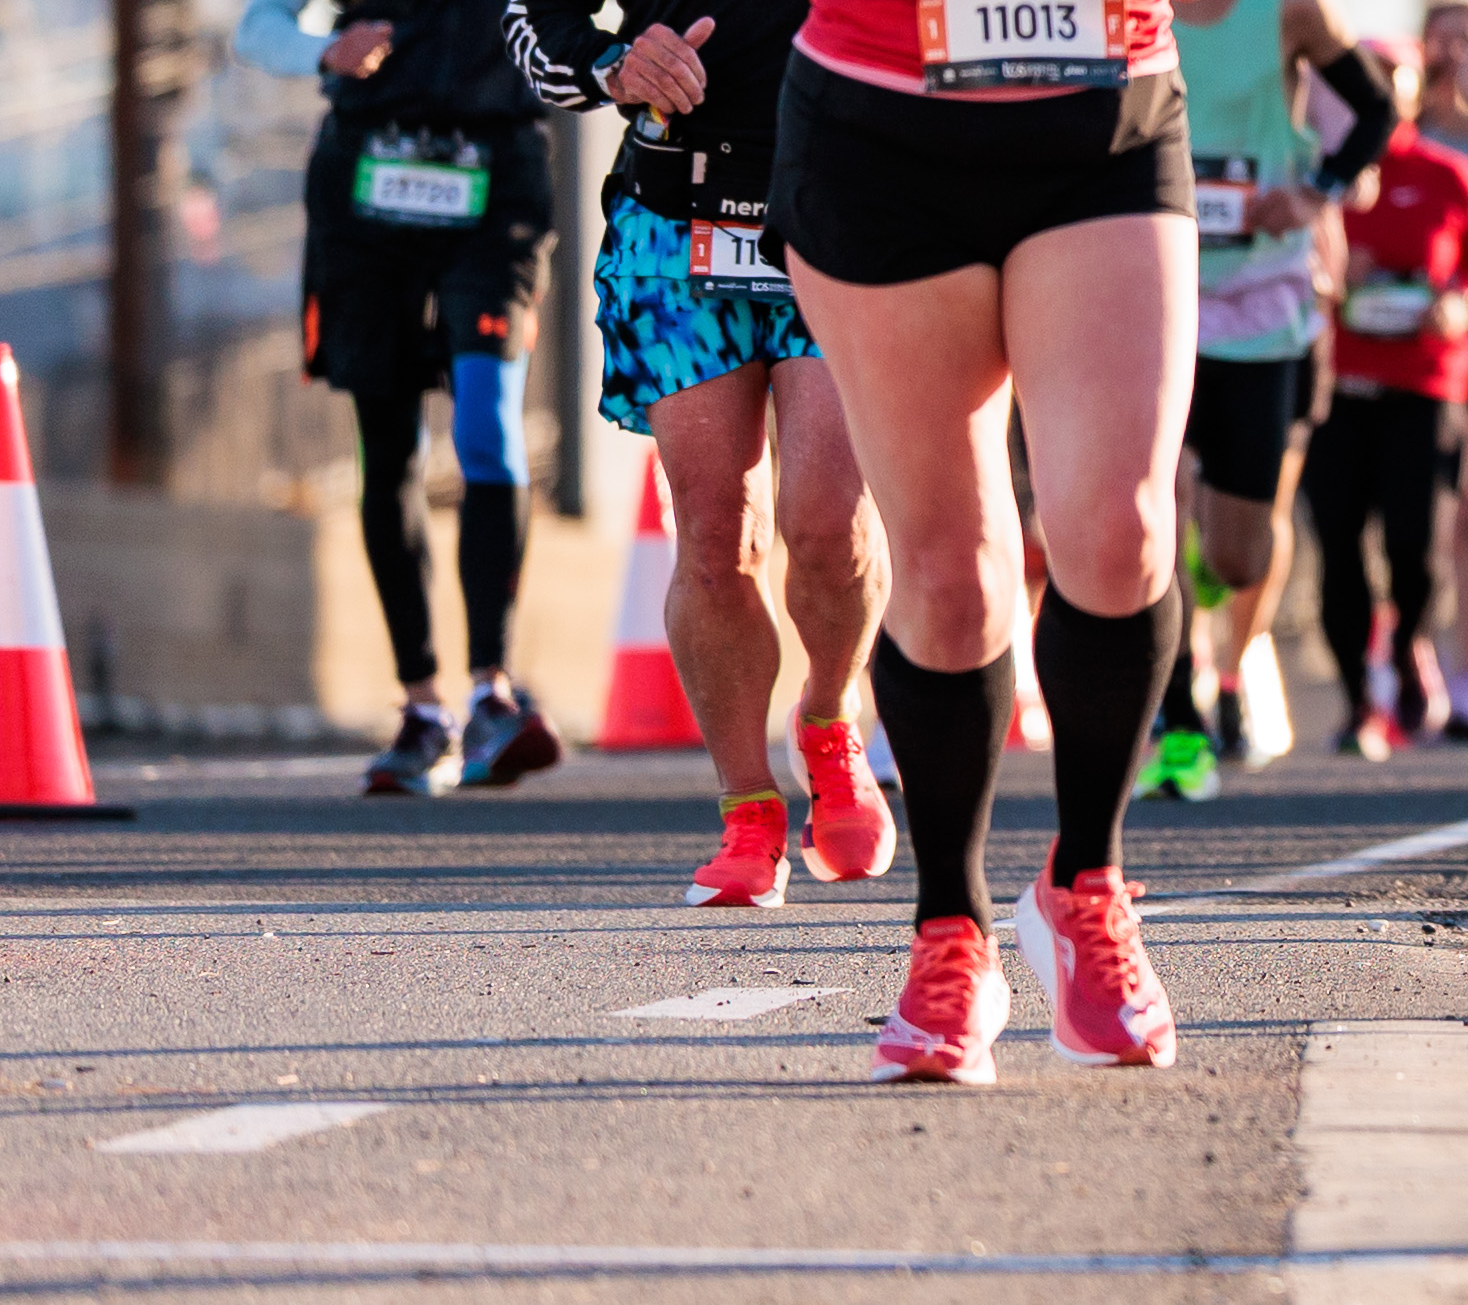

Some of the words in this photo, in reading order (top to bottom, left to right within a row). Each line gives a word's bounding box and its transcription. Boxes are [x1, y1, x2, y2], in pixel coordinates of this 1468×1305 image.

[976, 4, 1077, 42] 11013
[720, 198, 768, 216] ner
[697, 243, 705, 257] 1
[731, 237, 770, 266] 11
